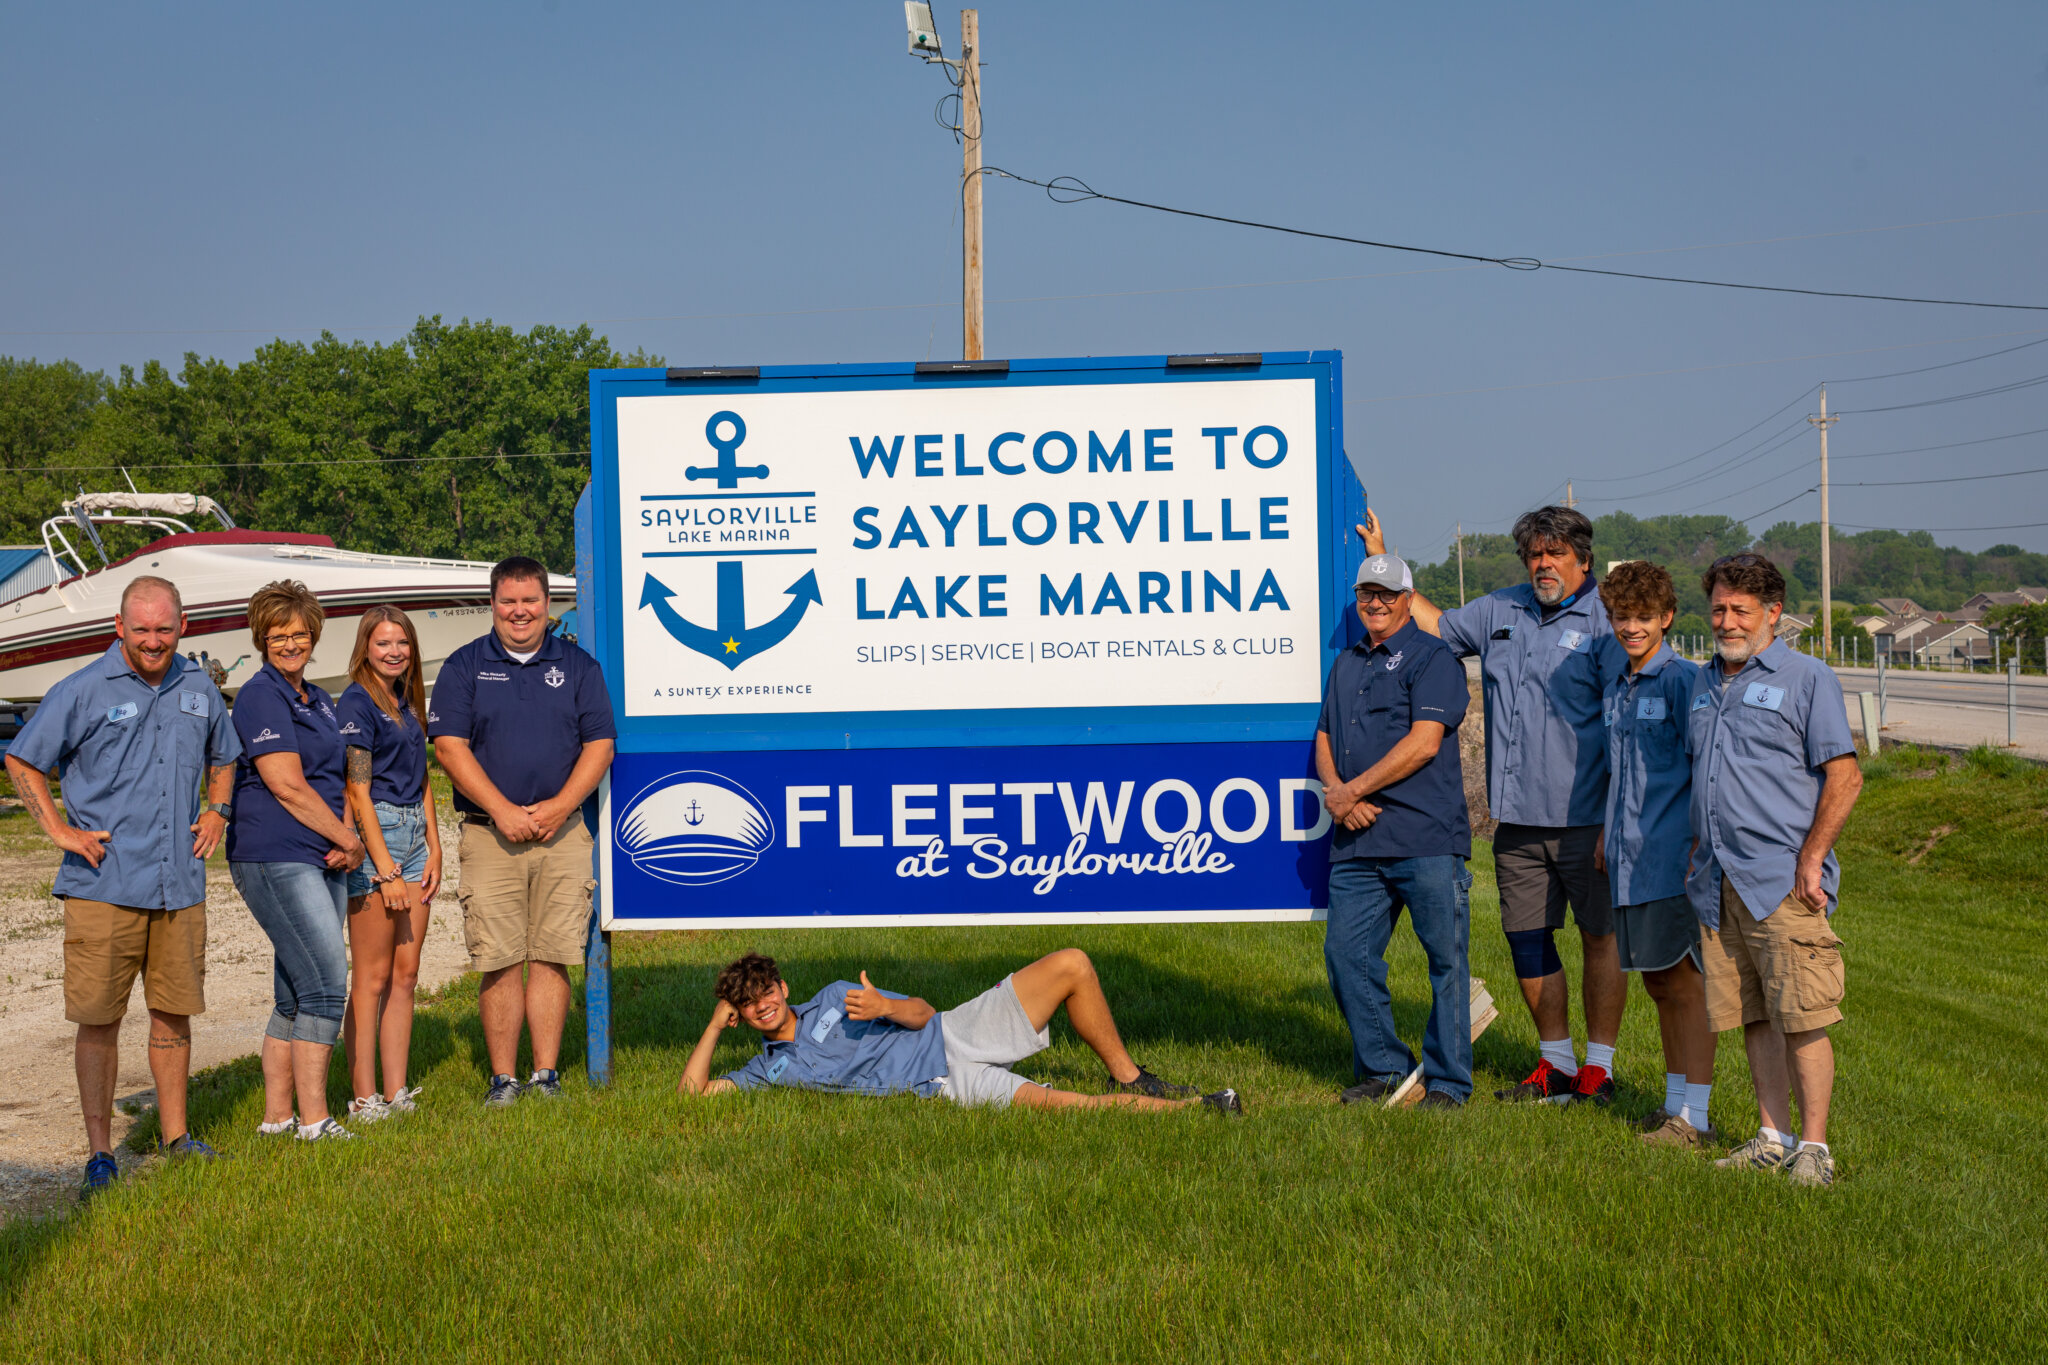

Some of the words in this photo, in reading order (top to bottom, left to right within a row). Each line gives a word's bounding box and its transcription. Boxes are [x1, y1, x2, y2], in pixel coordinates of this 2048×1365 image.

[848, 428, 1174, 480] WELCOME
[1201, 424, 1289, 470] TO
[641, 505, 817, 527] SAYLORVILLE
[668, 530, 711, 544] LAKE
[720, 528, 790, 542] MARINA
[852, 496, 1290, 550] SAYLORVILLE
[855, 574, 1008, 620] LAKE
[1039, 567, 1291, 617] MARINA
[857, 645, 917, 663] SLIPS
[931, 642, 1025, 661] SERVICE
[1041, 641, 1101, 659] BOAT
[1107, 638, 1206, 658] RENTALS
[1213, 638, 1227, 656] &
[1233, 637, 1294, 655] CLUB
[654, 688, 662, 697] A
[668, 685, 723, 699] SUNTEX
[728, 684, 812, 695] EXPERIENCE
[785, 777, 1333, 849] FLEETWOOD
[896, 838, 950, 878] at
[966, 830, 1236, 896] Saylorville
